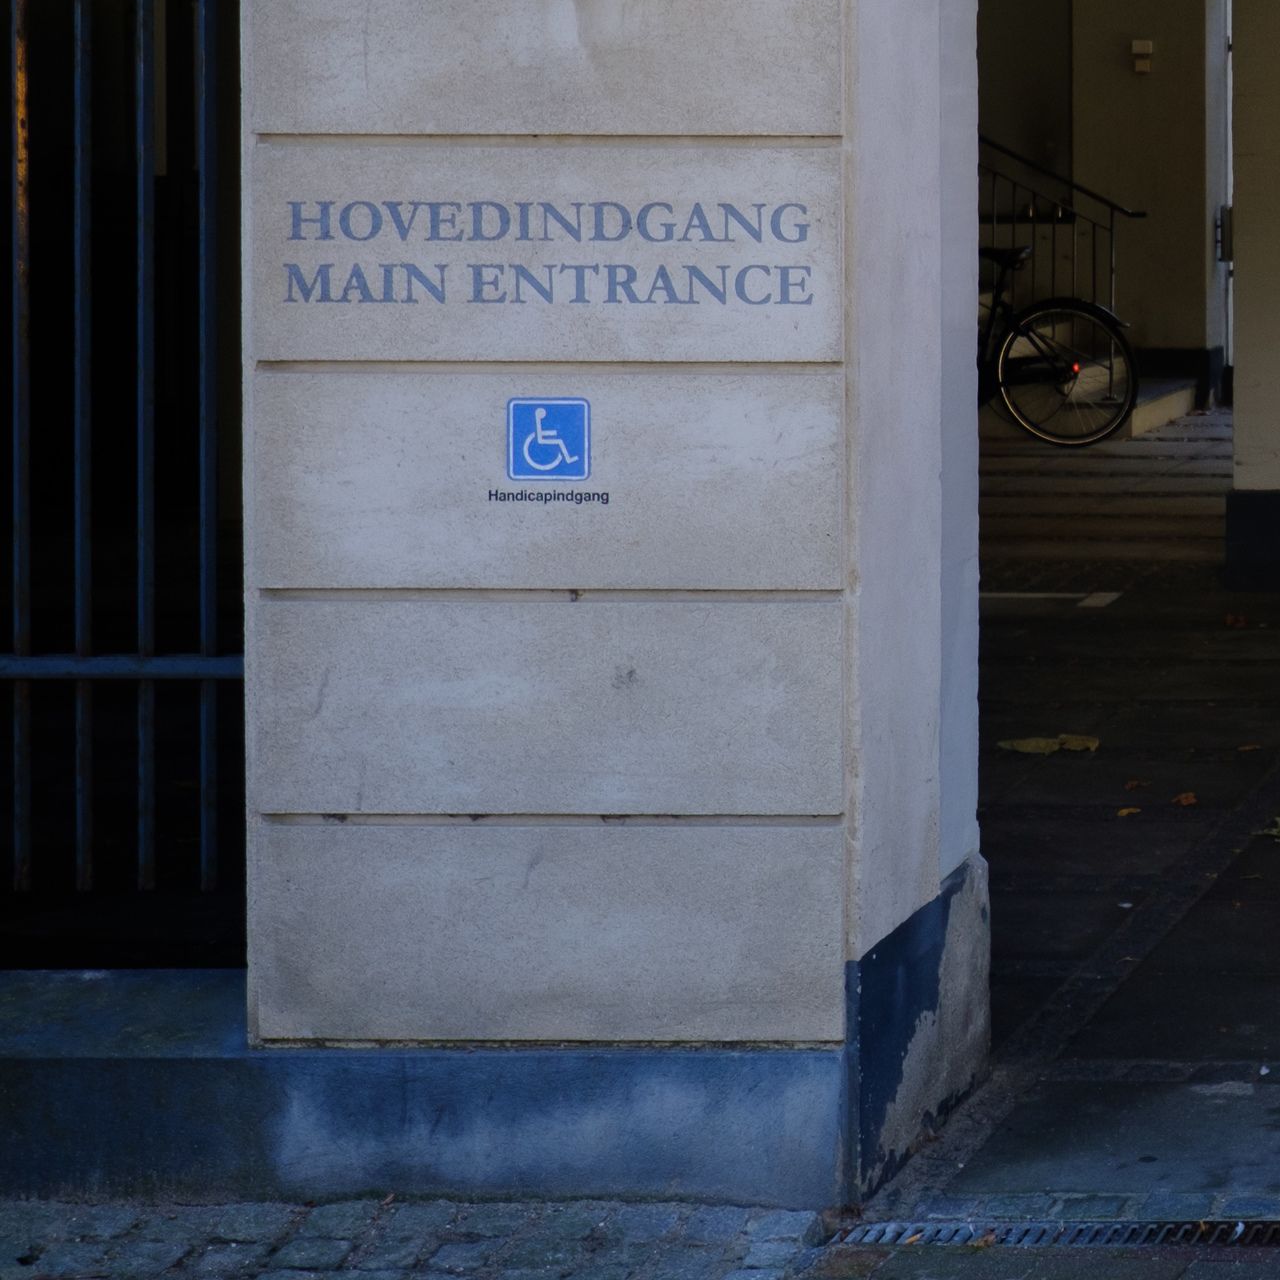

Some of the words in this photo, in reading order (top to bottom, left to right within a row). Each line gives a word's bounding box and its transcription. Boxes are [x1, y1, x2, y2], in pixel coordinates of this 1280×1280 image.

[286, 200, 809, 242] HOVEDINDGANG
[283, 263, 448, 304] MAIN
[466, 263, 815, 305] ENTRANCE
[488, 489, 609, 505] Handicapindgang
